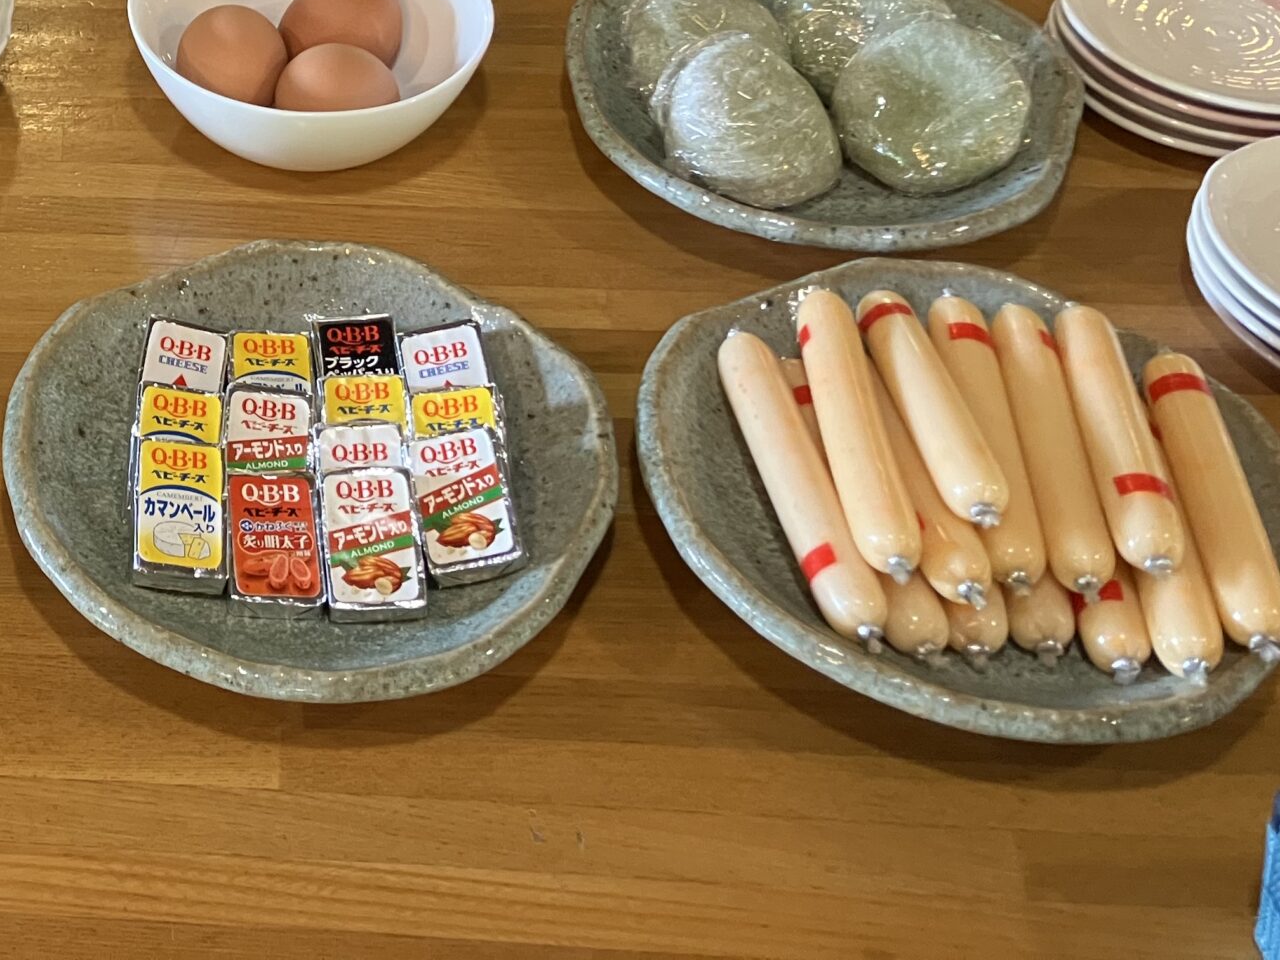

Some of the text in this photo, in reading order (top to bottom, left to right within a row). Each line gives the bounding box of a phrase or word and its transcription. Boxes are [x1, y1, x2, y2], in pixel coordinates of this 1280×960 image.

[158, 354, 209, 375] CHEESE
[244, 357, 297, 367] ベビーチーズ
[324, 354, 380, 370] ブラック
[419, 360, 470, 379] CHEESE
[336, 403, 394, 415] ベビーチーズ
[151, 414, 209, 432] ベビーチーズ
[240, 419, 299, 435] ベビーチーズ
[232, 440, 303, 460] アーモンド入り
[245, 460, 289, 470] ALMOND
[424, 458, 483, 478] ベビーチーズ
[151, 469, 210, 484] ベビーチーズ
[423, 473, 495, 514] アーモンド入り
[144, 496, 216, 523] カマンベール
[243, 506, 302, 517] ベビーチーズ
[337, 502, 397, 515] ベビーチーズ
[442, 494, 485, 519] ALMOND
[193, 522, 215, 534] 入り
[333, 519, 408, 551] アーモンド入り
[242, 533, 309, 550] 炙り明太子
[350, 541, 395, 558] ALMOND
